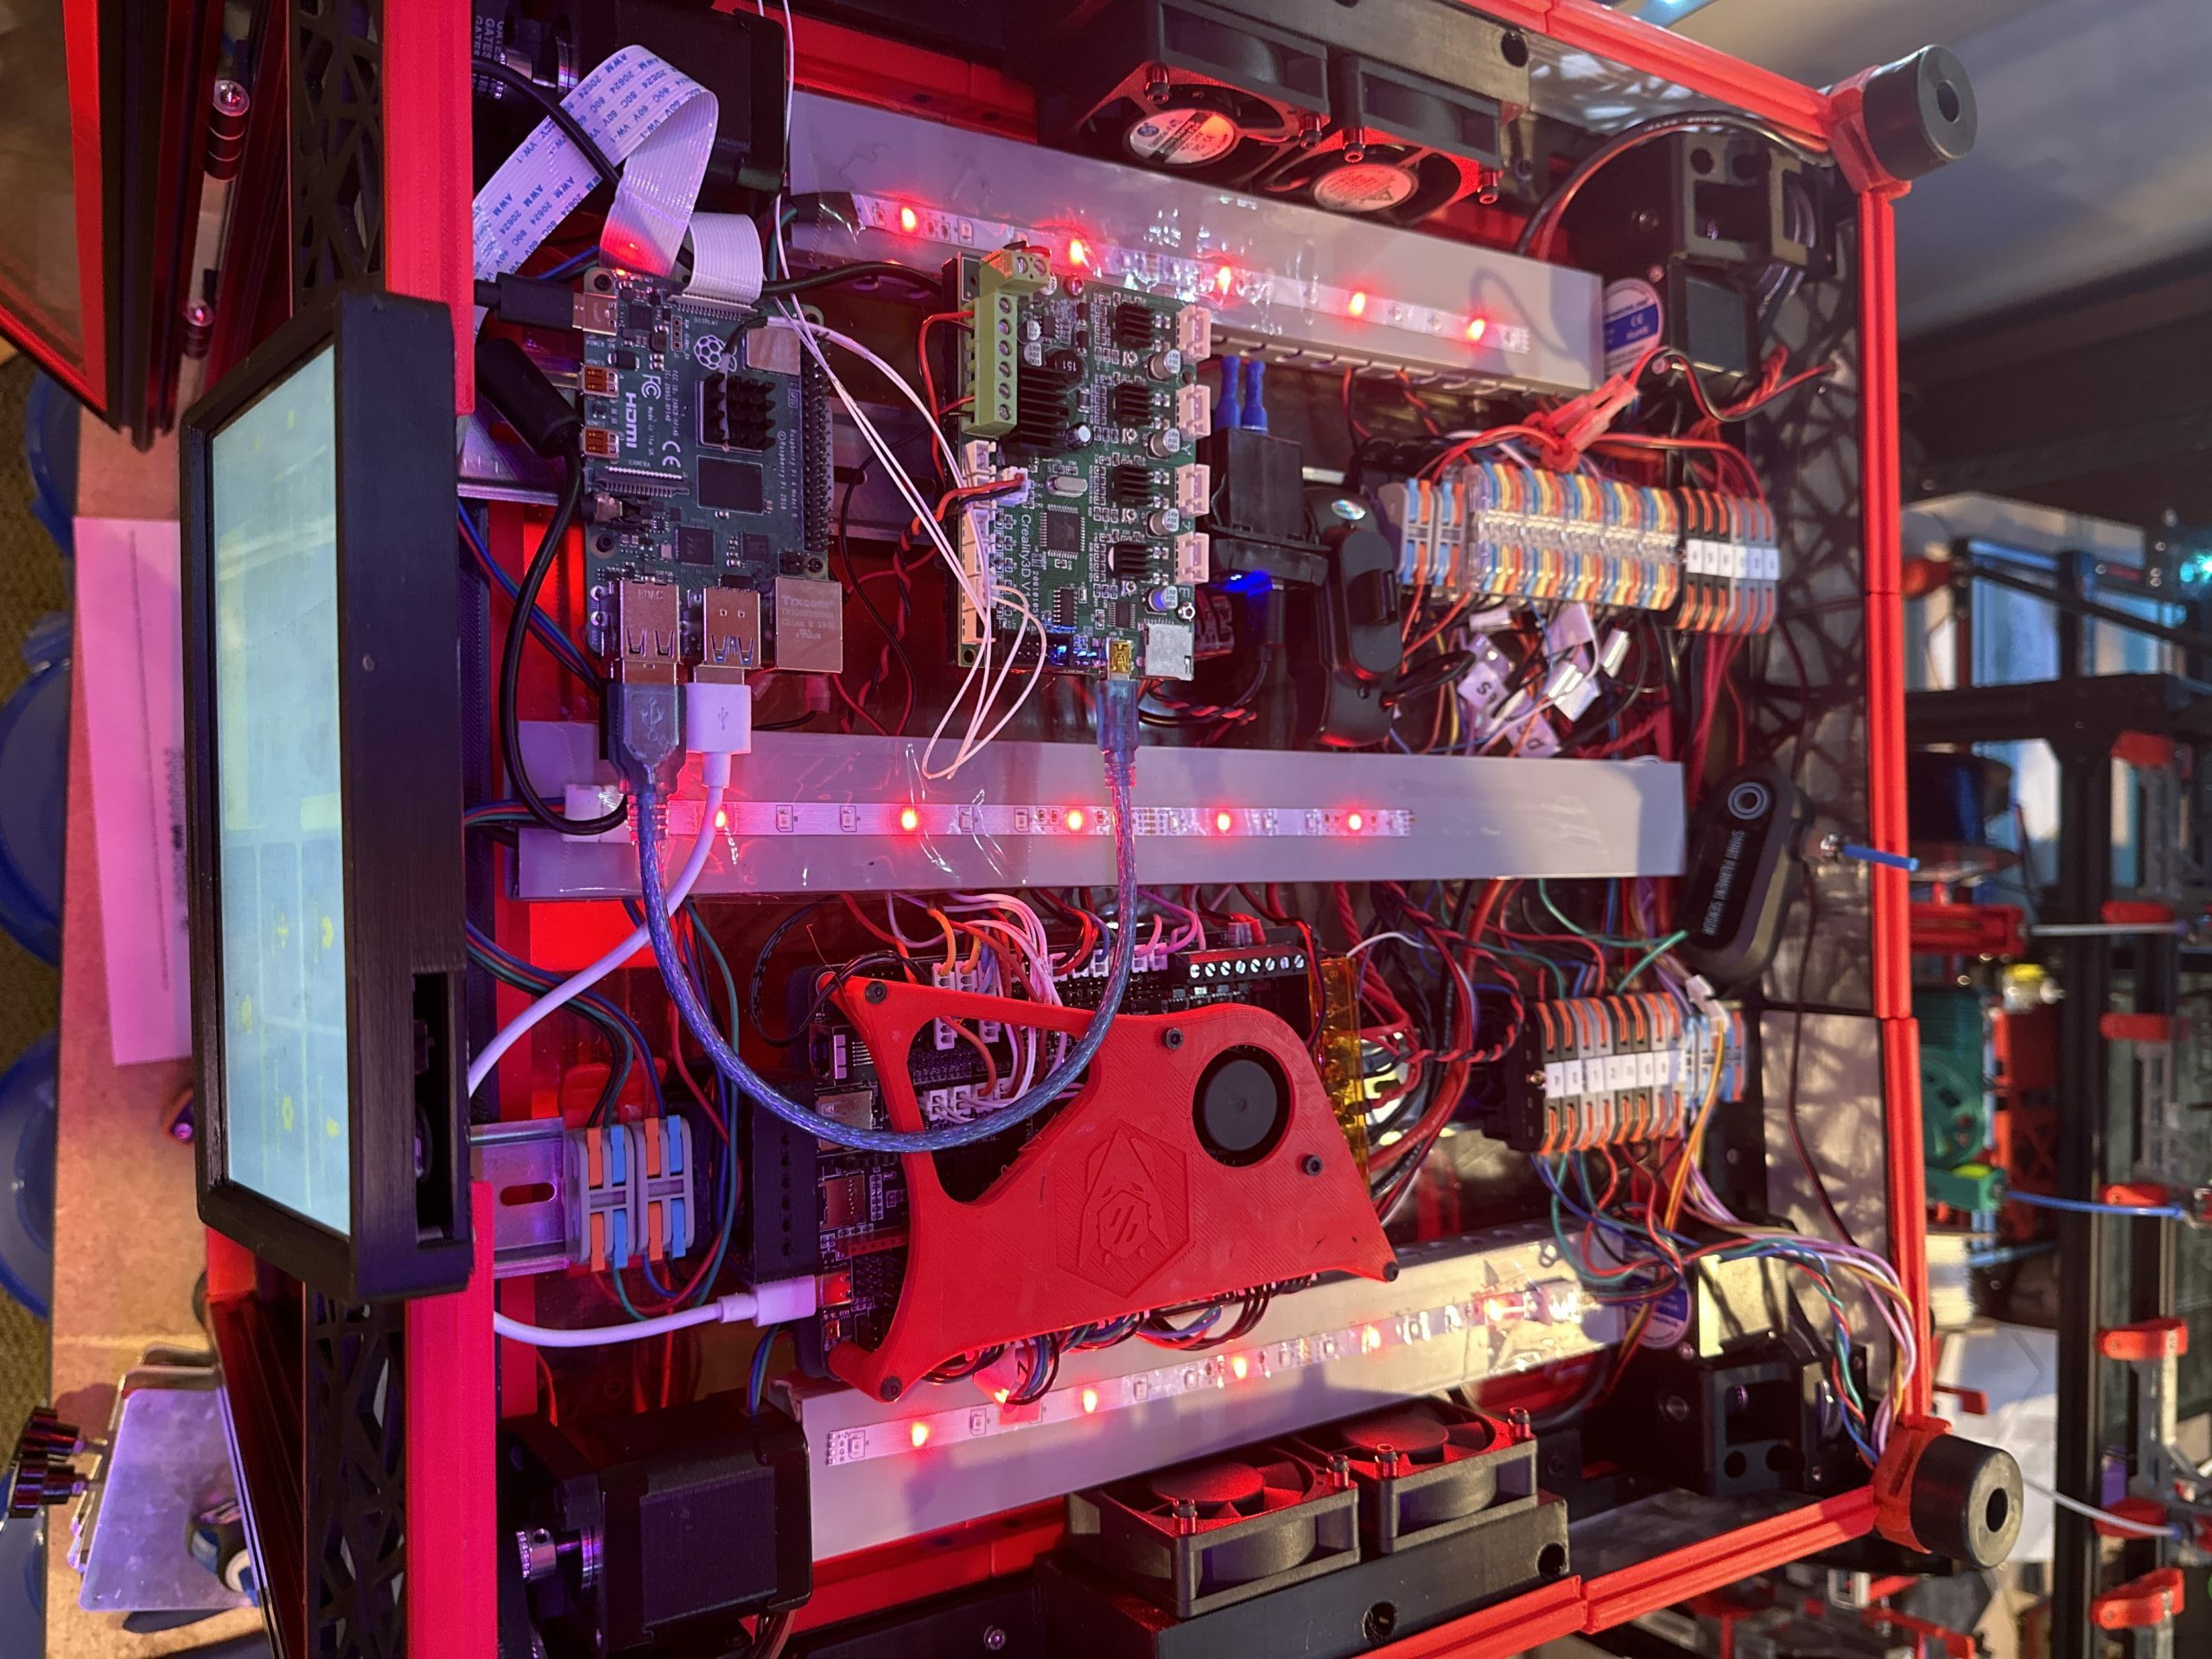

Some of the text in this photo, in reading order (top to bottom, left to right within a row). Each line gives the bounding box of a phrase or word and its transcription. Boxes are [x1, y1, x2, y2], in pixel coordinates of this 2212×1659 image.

[482, 17, 495, 60] GATES
[605, 53, 627, 73] AWM
[609, 71, 634, 93] 20624
[620, 91, 638, 108] 80C
[652, 86, 669, 102] 80C
[588, 97, 606, 112] 80C
[632, 105, 649, 120] 60V
[601, 110, 617, 124] 60V
[609, 123, 630, 142] VW-1
[516, 142, 537, 163] VW-1
[523, 184, 543, 207] AWM
[554, 176, 575, 198] AWM
[493, 194, 512, 215] AWM
[530, 200, 552, 225] 20624
[499, 210, 521, 234] 20624
[511, 229, 527, 245] 80C
[694, 317, 719, 326] DISPLAY
[1630, 312, 1644, 327] CE
[1063, 360, 1077, 372] 151
[626, 392, 637, 448] HDMI
[662, 441, 681, 467] CE
[1181, 444, 1192, 455] Y
[629, 459, 651, 467] CAMERA
[1020, 514, 1032, 578] Creality3D
[1179, 588, 1190, 598] E
